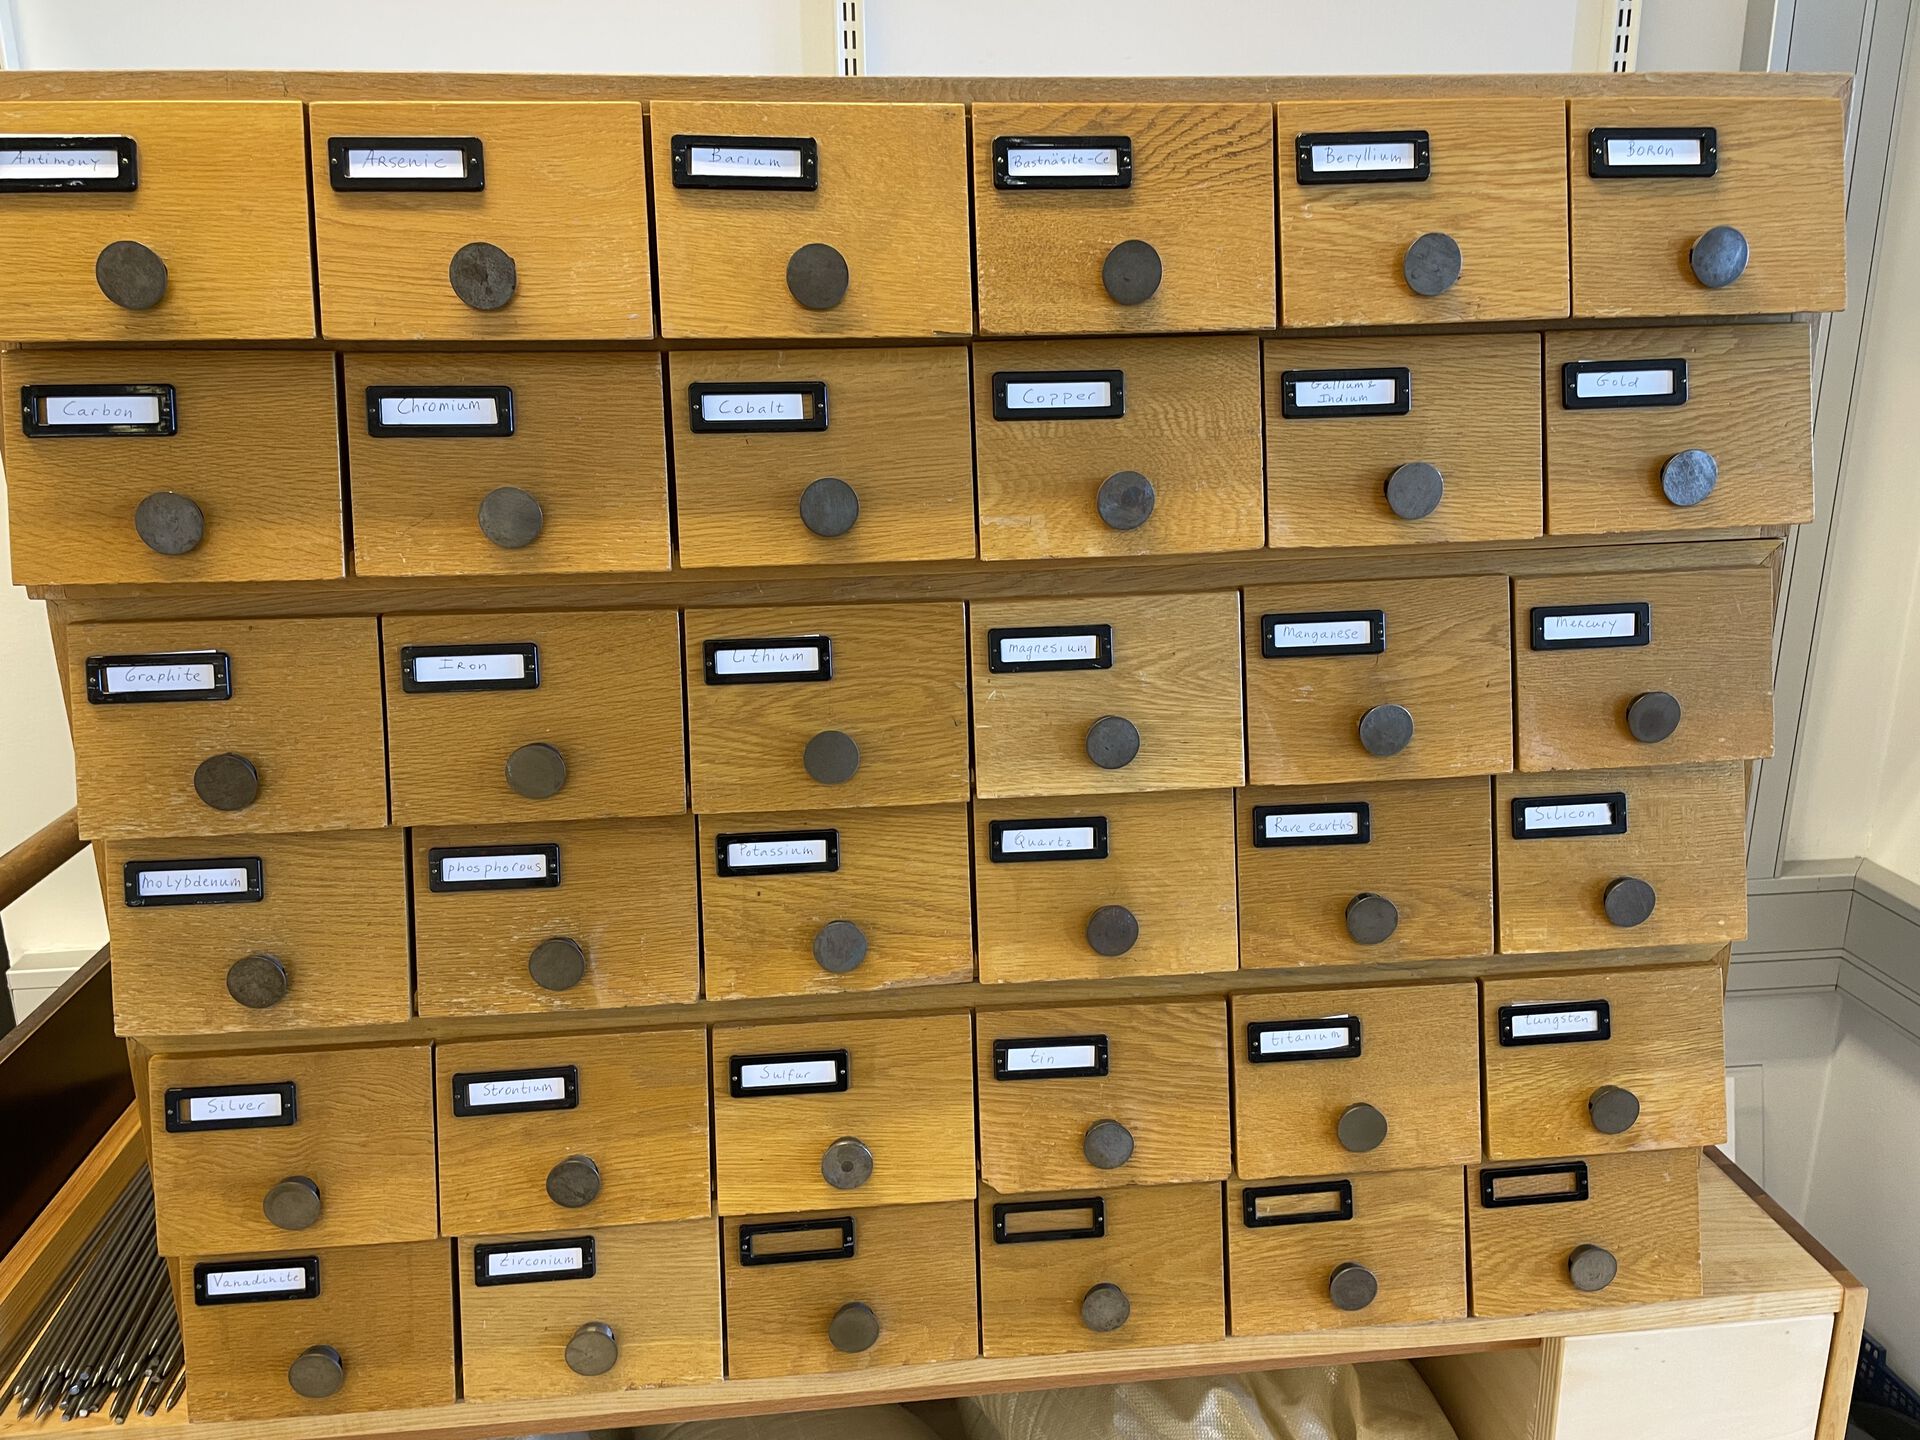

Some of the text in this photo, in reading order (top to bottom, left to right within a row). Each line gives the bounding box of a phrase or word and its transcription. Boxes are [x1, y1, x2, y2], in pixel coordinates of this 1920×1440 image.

[11, 151, 101, 172] Antimony
[709, 148, 781, 168] Barium
[1324, 147, 1402, 168] Beryllium
[1596, 373, 1640, 389] Gold
[1022, 389, 1097, 407] Copper
[1317, 393, 1368, 404] Indium
[63, 400, 136, 419] Carbon
[397, 400, 482, 415] Chromium
[719, 400, 785, 415] Cobalt
[1283, 624, 1360, 644] Manganese
[124, 666, 203, 684] Graphite
[1273, 815, 1355, 834] Rare earths
[1014, 833, 1073, 848] Quartz
[740, 844, 814, 858] Potassium
[1030, 1049, 1055, 1065] tin
[759, 1066, 811, 1081] Sulfur
[483, 1081, 555, 1097] Strontium
[213, 1273, 301, 1288] Vanadinite
